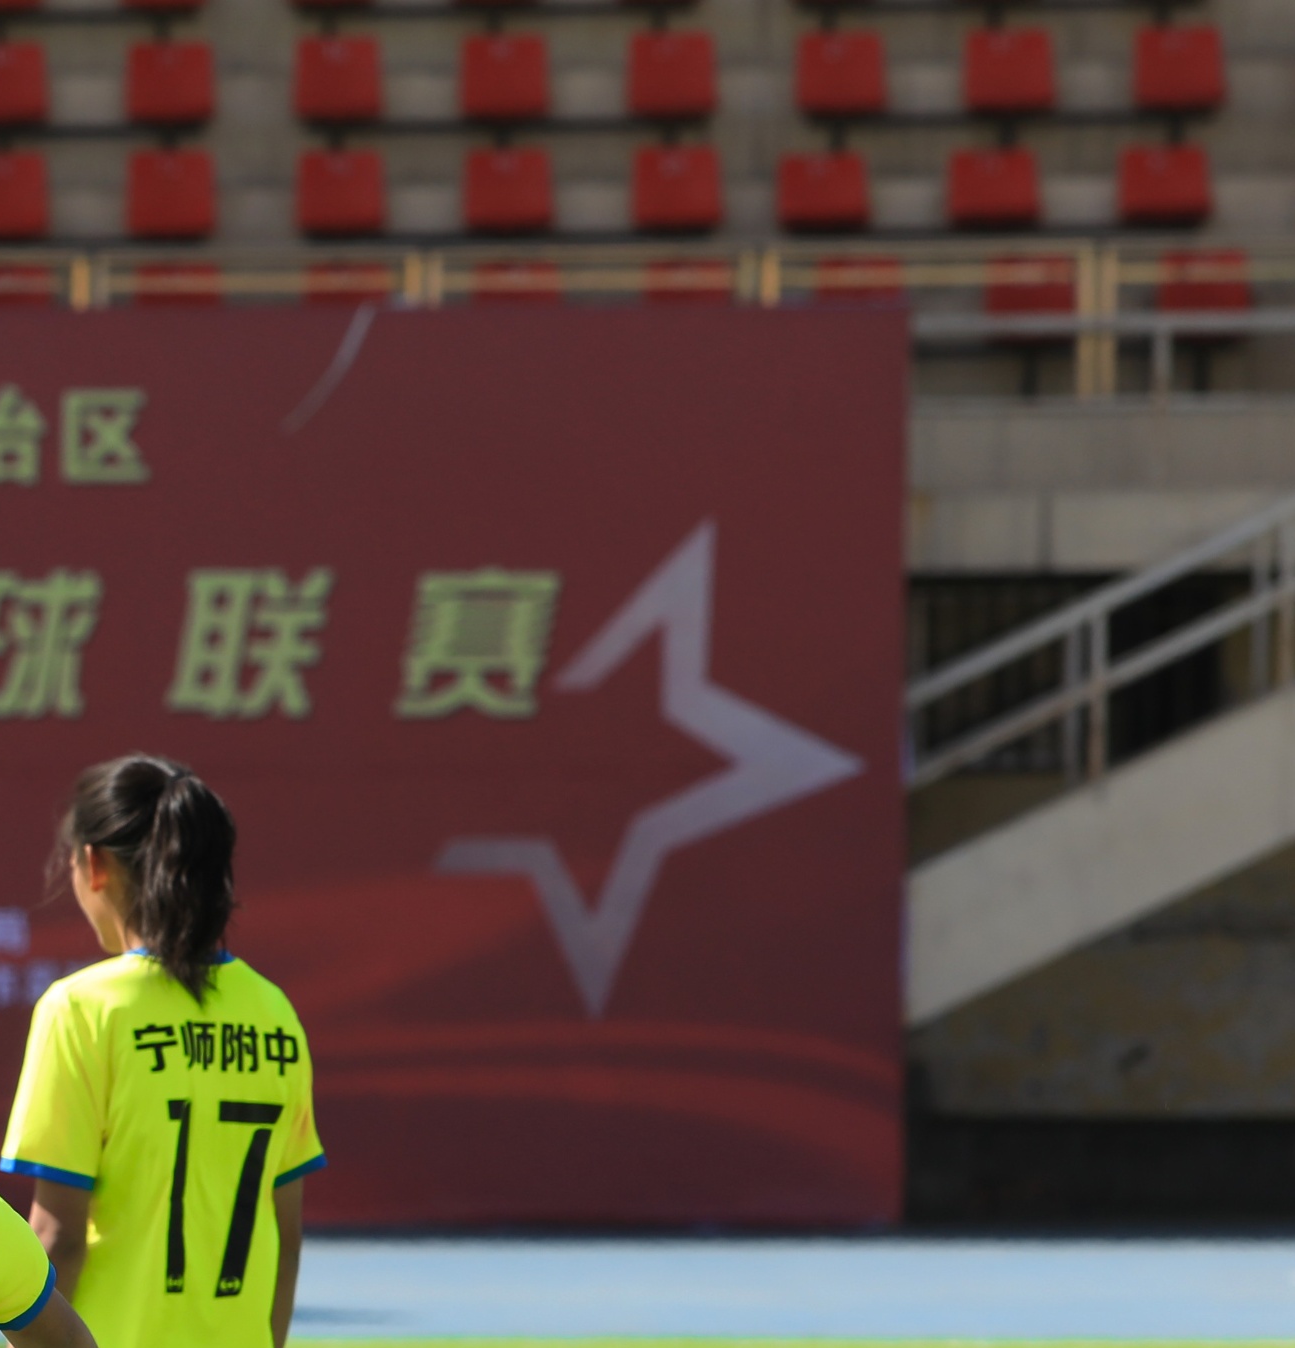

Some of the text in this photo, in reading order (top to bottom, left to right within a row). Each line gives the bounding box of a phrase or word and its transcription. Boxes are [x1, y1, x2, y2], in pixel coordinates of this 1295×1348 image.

[132, 1020, 299, 1076] 宁师附中
[165, 1099, 284, 1298] 17
